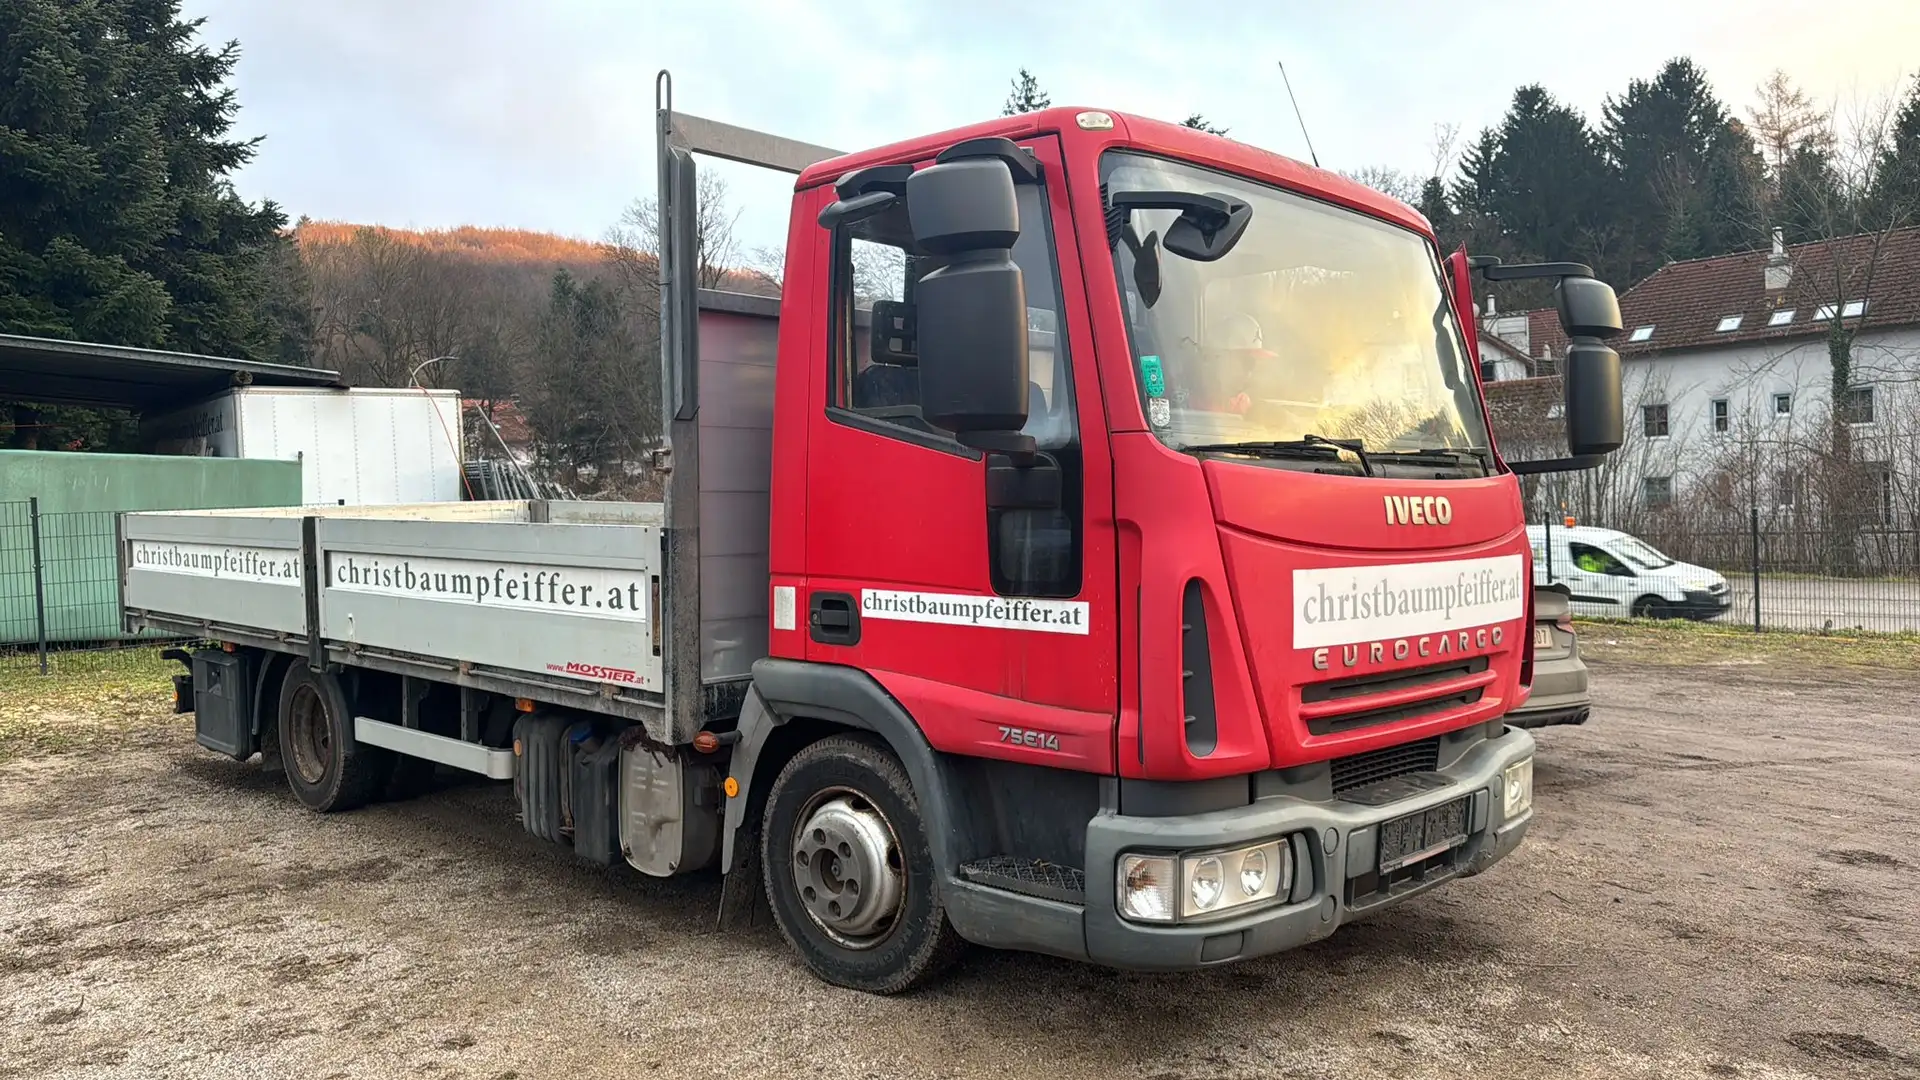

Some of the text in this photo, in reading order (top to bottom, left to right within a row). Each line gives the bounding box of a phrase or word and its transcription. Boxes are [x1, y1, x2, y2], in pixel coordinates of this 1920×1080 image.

[1383, 495, 1452, 525] IVECO
[136, 544, 300, 579] christbaumpfeiffer.at
[337, 558, 639, 611] christbaumpfeiffer.at
[1303, 569, 1520, 624] christbaumpfeiffer.at
[863, 592, 1081, 626] christbaumpfeiffer.at
[1313, 626, 1504, 670] EUROCARGO
[1533, 629, 1547, 644] 07
[998, 726, 1059, 751] 75E14
